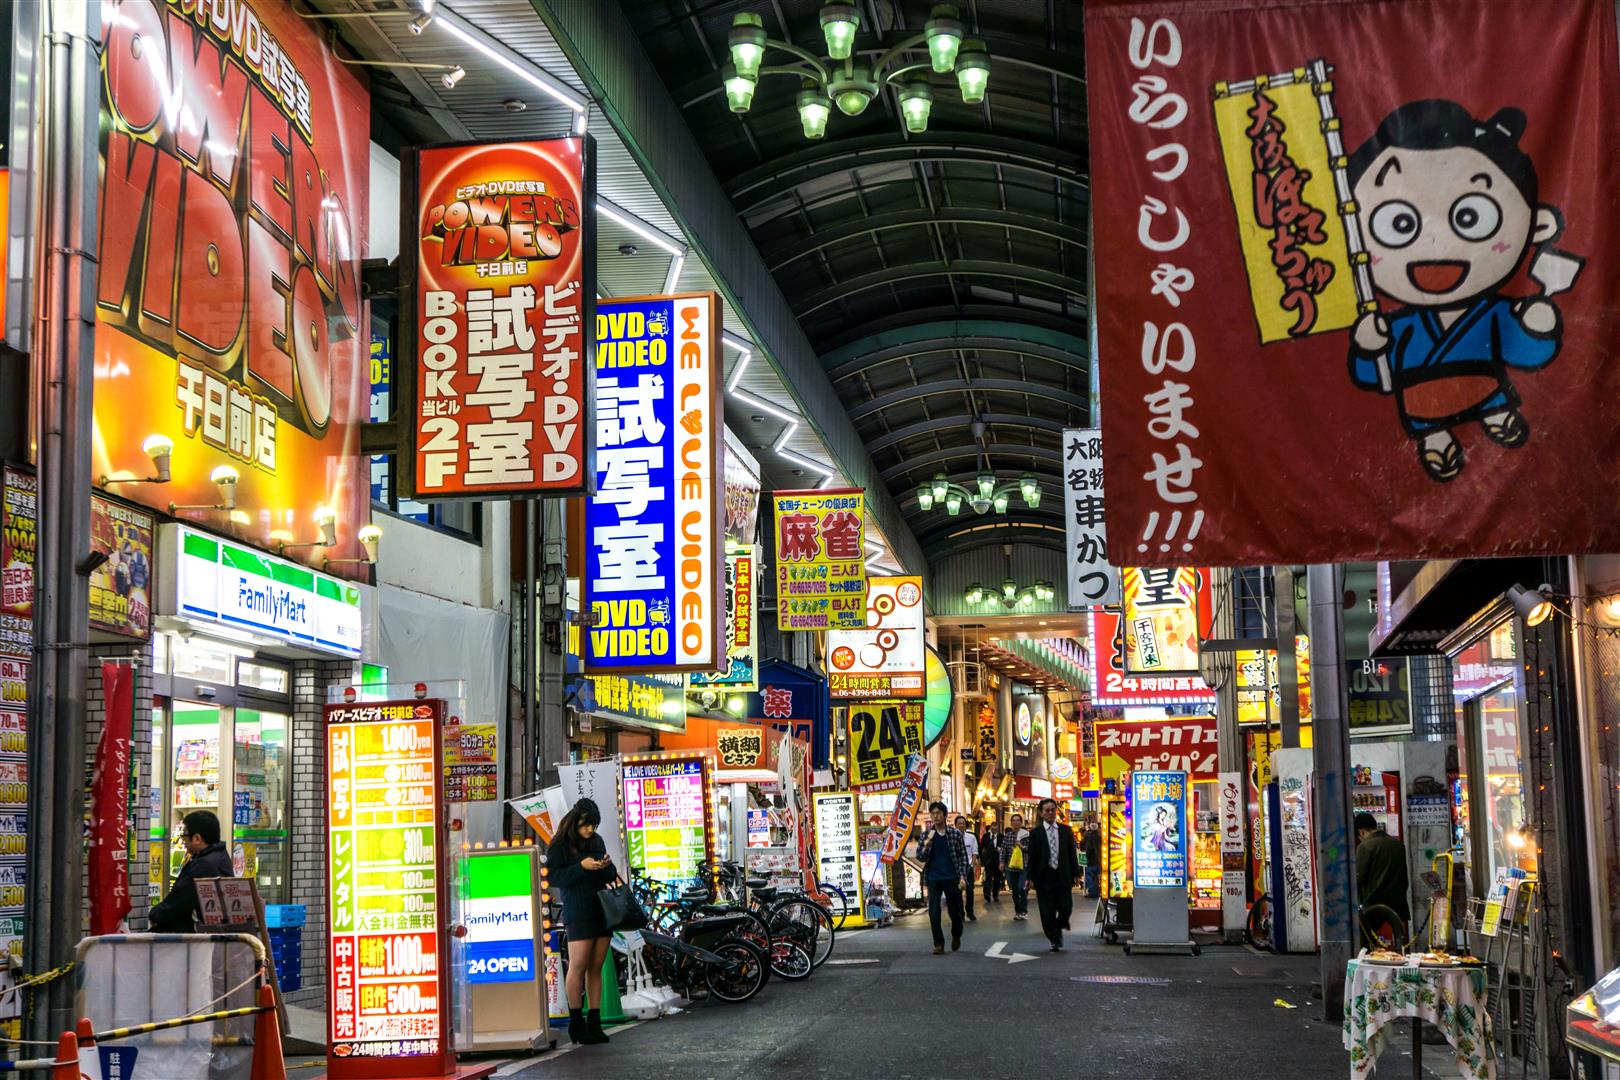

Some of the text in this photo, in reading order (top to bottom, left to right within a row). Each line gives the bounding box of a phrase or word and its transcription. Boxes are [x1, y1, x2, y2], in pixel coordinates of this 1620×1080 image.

[441, 222, 563, 267] VIDEO
[476, 261, 528, 277] 千日前店
[597, 311, 645, 340] DVD
[680, 306, 702, 370] WE
[423, 290, 459, 398] BOOK
[597, 338, 667, 369] VIDEO
[464, 285, 537, 485] 試写室
[541, 280, 581, 483] ビデオ・DVD
[177, 360, 278, 474] 千日前店
[422, 400, 461, 416] 当ビル
[419, 417, 461, 488] 2F
[592, 373, 666, 593] 試写室
[778, 497, 861, 511] 全国チェーンの優良店!
[779, 511, 863, 562] 麻雀
[1075, 494, 1110, 600] 串かつ
[3, 567, 32, 585] 西日本
[680, 511, 703, 656] VIDEO
[831, 564, 860, 577] 三人打
[239, 577, 306, 624] FamilyMart
[591, 598, 647, 629] DVD
[735, 560, 751, 643] 日本一の試写室
[832, 599, 861, 611] 四人打
[590, 627, 669, 659] VIDEO
[831, 673, 891, 690] 24時間営業
[1105, 673, 1210, 693] 24時間営業
[590, 675, 664, 721] 時間営業・年中無休
[763, 689, 793, 718] 薬
[460, 734, 497, 748] 90分コース
[718, 736, 761, 754] 横綱
[851, 707, 921, 763] 24 時間
[1099, 725, 1219, 748] ネットカフェ
[723, 753, 757, 766] ビデオ
[858, 754, 912, 781] 居酒
[1135, 751, 1218, 773] ポパイ
[332, 731, 350, 820] 試写
[1136, 782, 1183, 800] 吉祥坊
[631, 831, 643, 867] レンタ
[335, 834, 352, 928] レンタル
[358, 913, 435, 931] 入会料金無料
[465, 911, 529, 927] FamilyMart
[335, 938, 354, 1037] 中古販売
[361, 986, 387, 1008] 旧作
